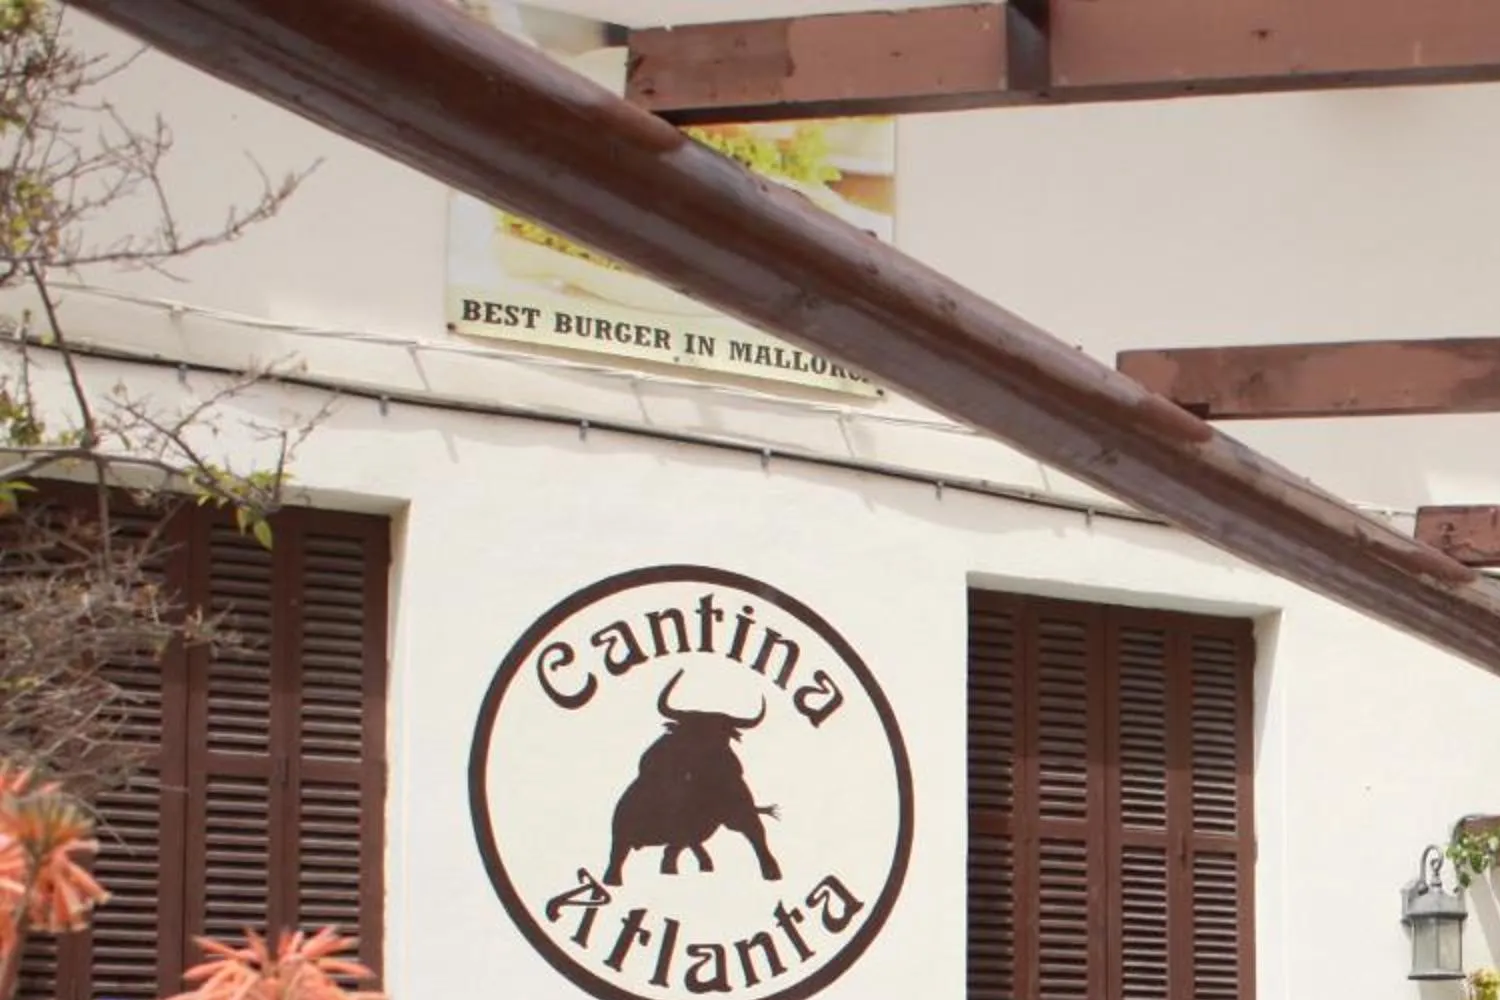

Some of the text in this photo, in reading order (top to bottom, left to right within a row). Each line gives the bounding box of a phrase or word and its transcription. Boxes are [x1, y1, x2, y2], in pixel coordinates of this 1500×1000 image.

[461, 299, 869, 382] BEST BURGER IN MALLOR
[536, 593, 844, 728] Cantina
[545, 867, 865, 994] Atlanta
